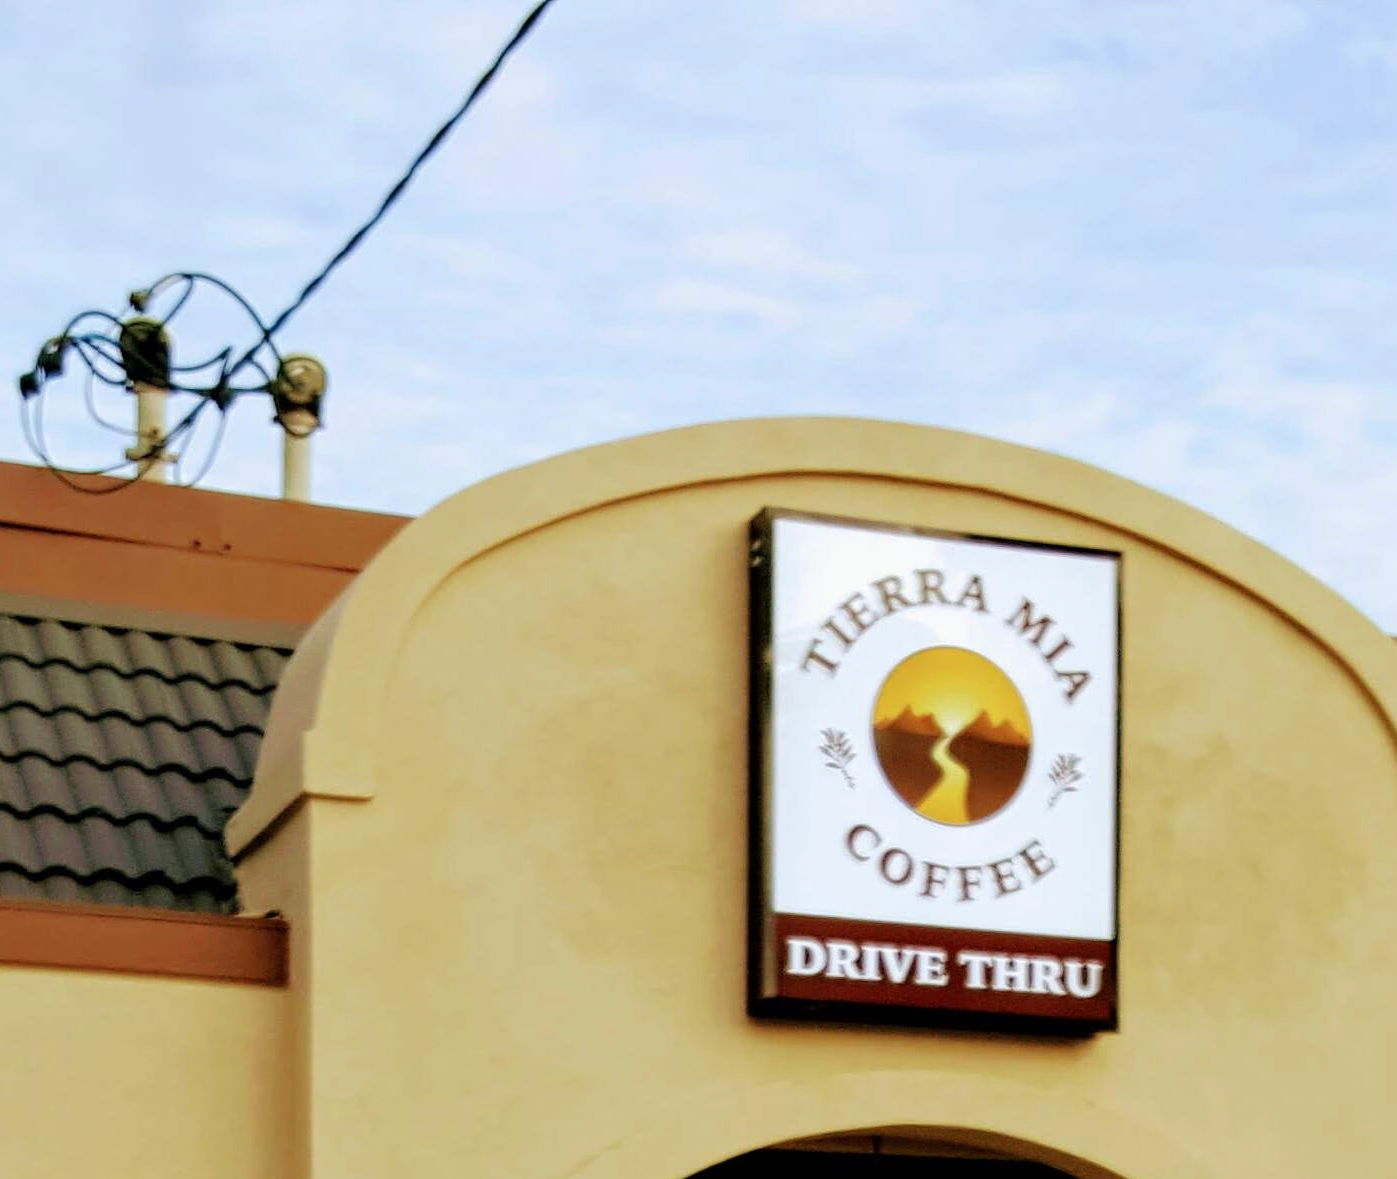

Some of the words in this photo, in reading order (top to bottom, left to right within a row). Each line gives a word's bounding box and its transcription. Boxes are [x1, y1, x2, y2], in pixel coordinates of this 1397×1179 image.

[802, 569, 991, 679] TIERRA
[1005, 597, 1093, 704] MIA
[844, 823, 1056, 901] COFFEE
[786, 936, 948, 987] DRIVE
[958, 951, 1104, 998] THRU
